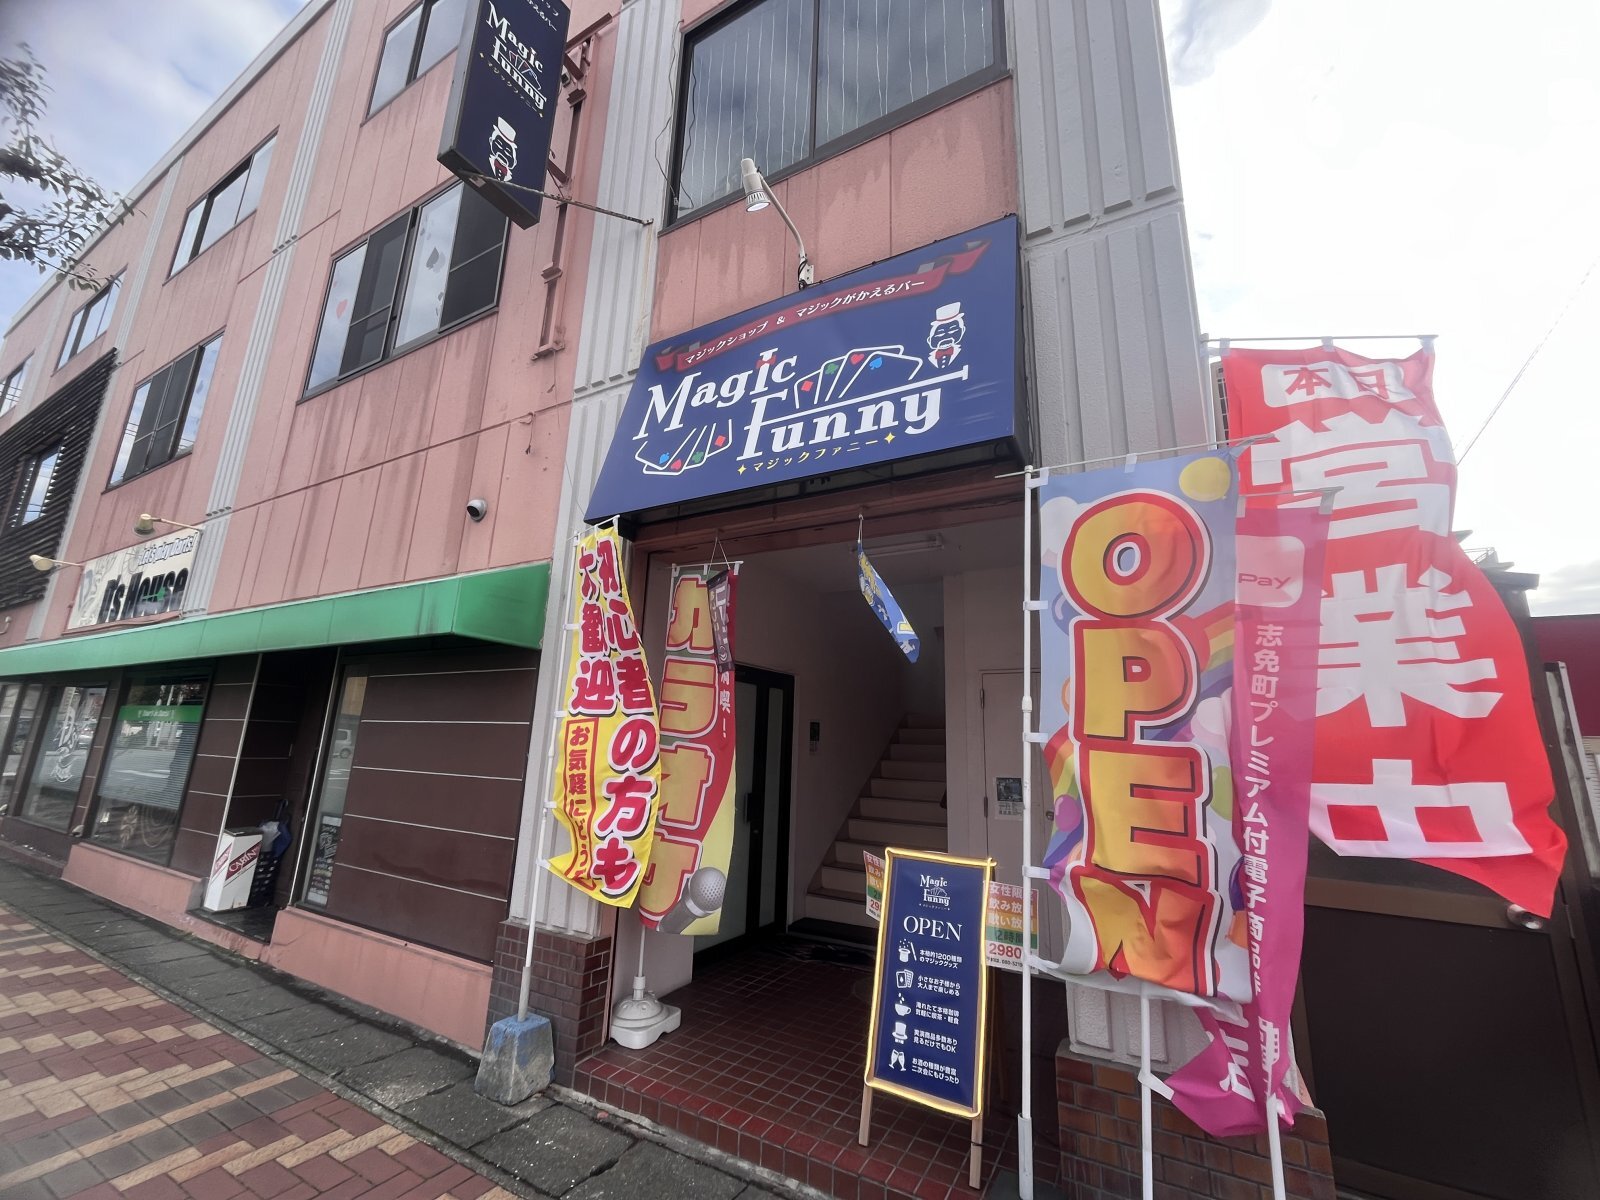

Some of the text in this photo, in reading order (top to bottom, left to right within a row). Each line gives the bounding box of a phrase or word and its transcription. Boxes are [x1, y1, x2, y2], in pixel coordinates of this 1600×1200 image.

[485, 0, 544, 73] Magic
[491, 36, 547, 110] Funny
[684, 279, 925, 365] マジックショップ & マジックがかえるバー
[632, 348, 799, 441] Magic
[737, 366, 968, 462] Funny
[1283, 367, 1391, 400] 本日
[752, 440, 878, 472] マジックファニー
[120, 568, 189, 620] House
[569, 545, 617, 714] 大歓迎
[1250, 408, 1533, 858] 営業中
[590, 538, 659, 896] 初心者の方も
[639, 574, 718, 922] カラオケ
[1057, 487, 1219, 998] OPEN
[920, 874, 948, 888] Magic
[923, 888, 950, 906] Funny
[903, 915, 962, 941] OPEN
